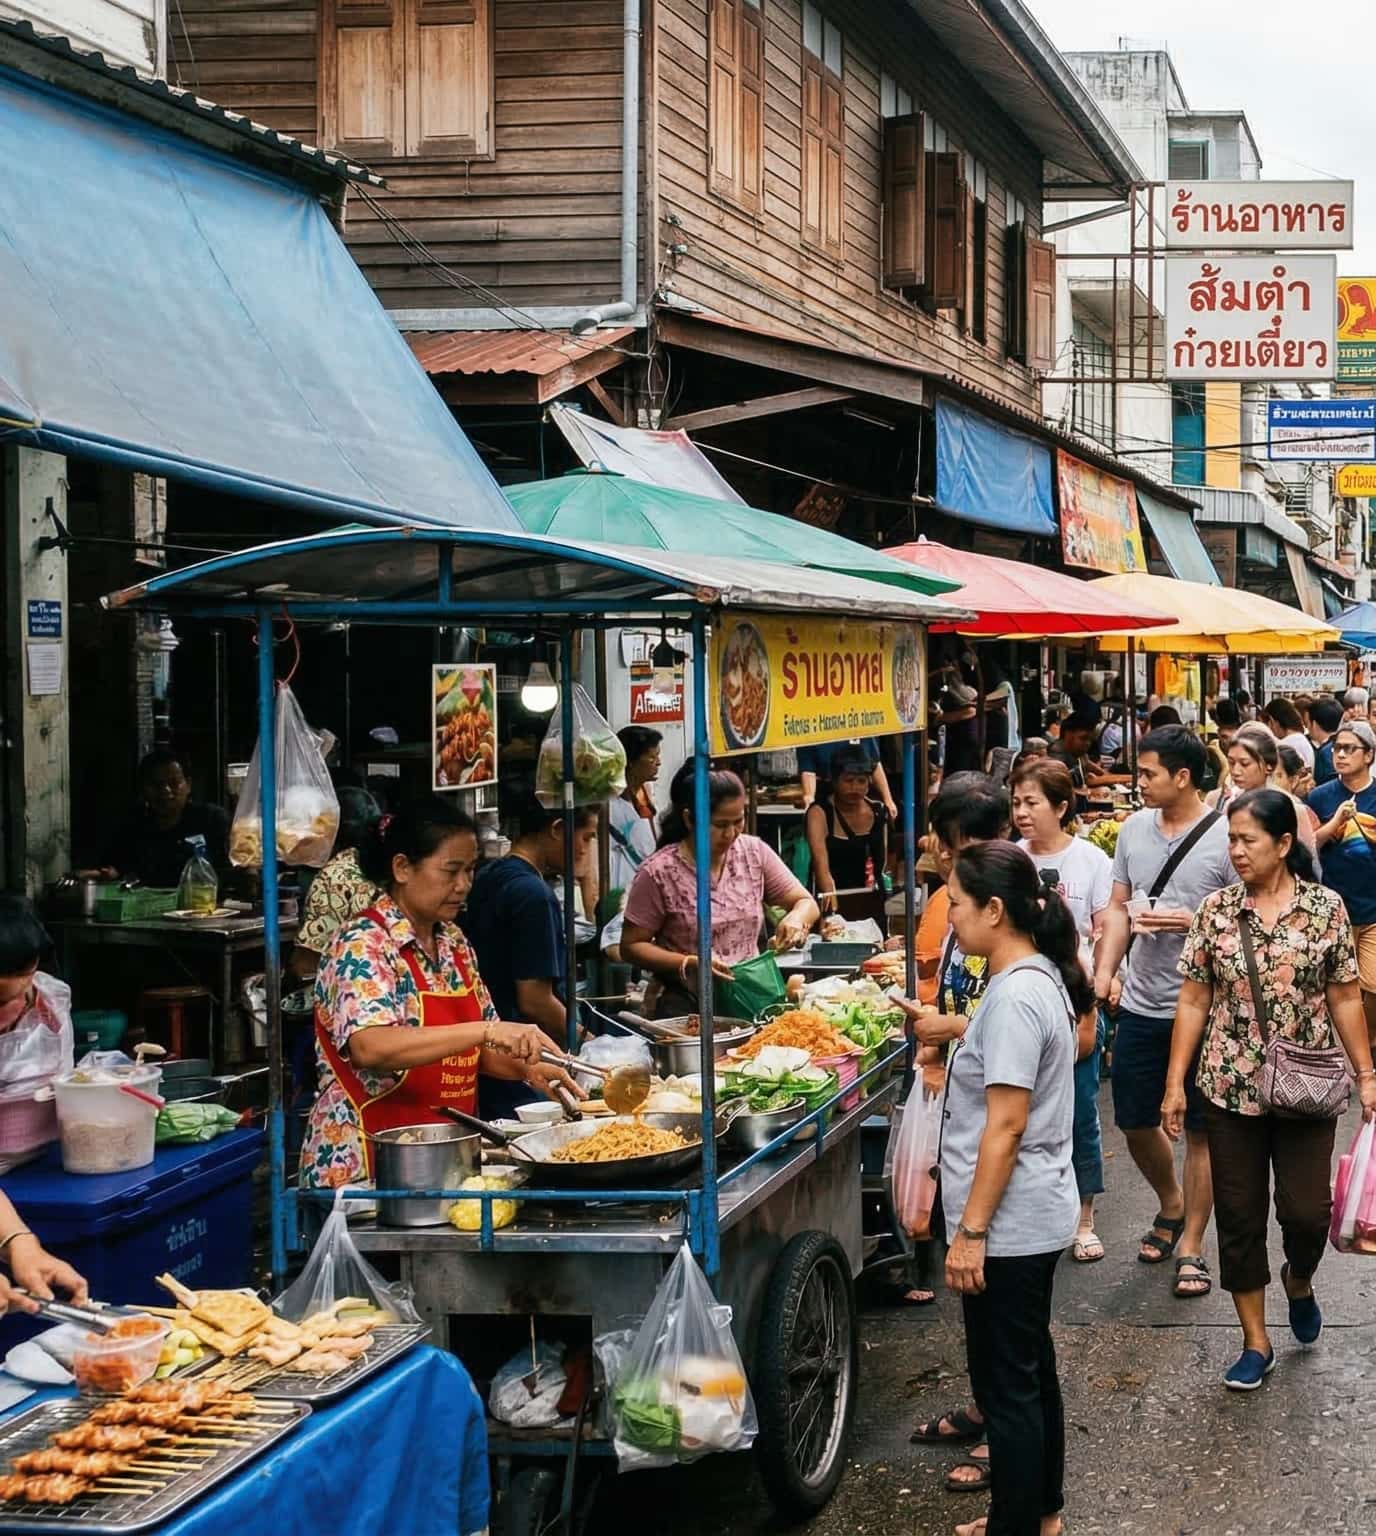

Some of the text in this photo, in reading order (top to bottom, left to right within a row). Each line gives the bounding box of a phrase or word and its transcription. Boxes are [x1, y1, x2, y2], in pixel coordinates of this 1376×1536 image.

[1171, 189, 1346, 232] ร้านอาหาร
[1188, 263, 1311, 311] ส้มตำ
